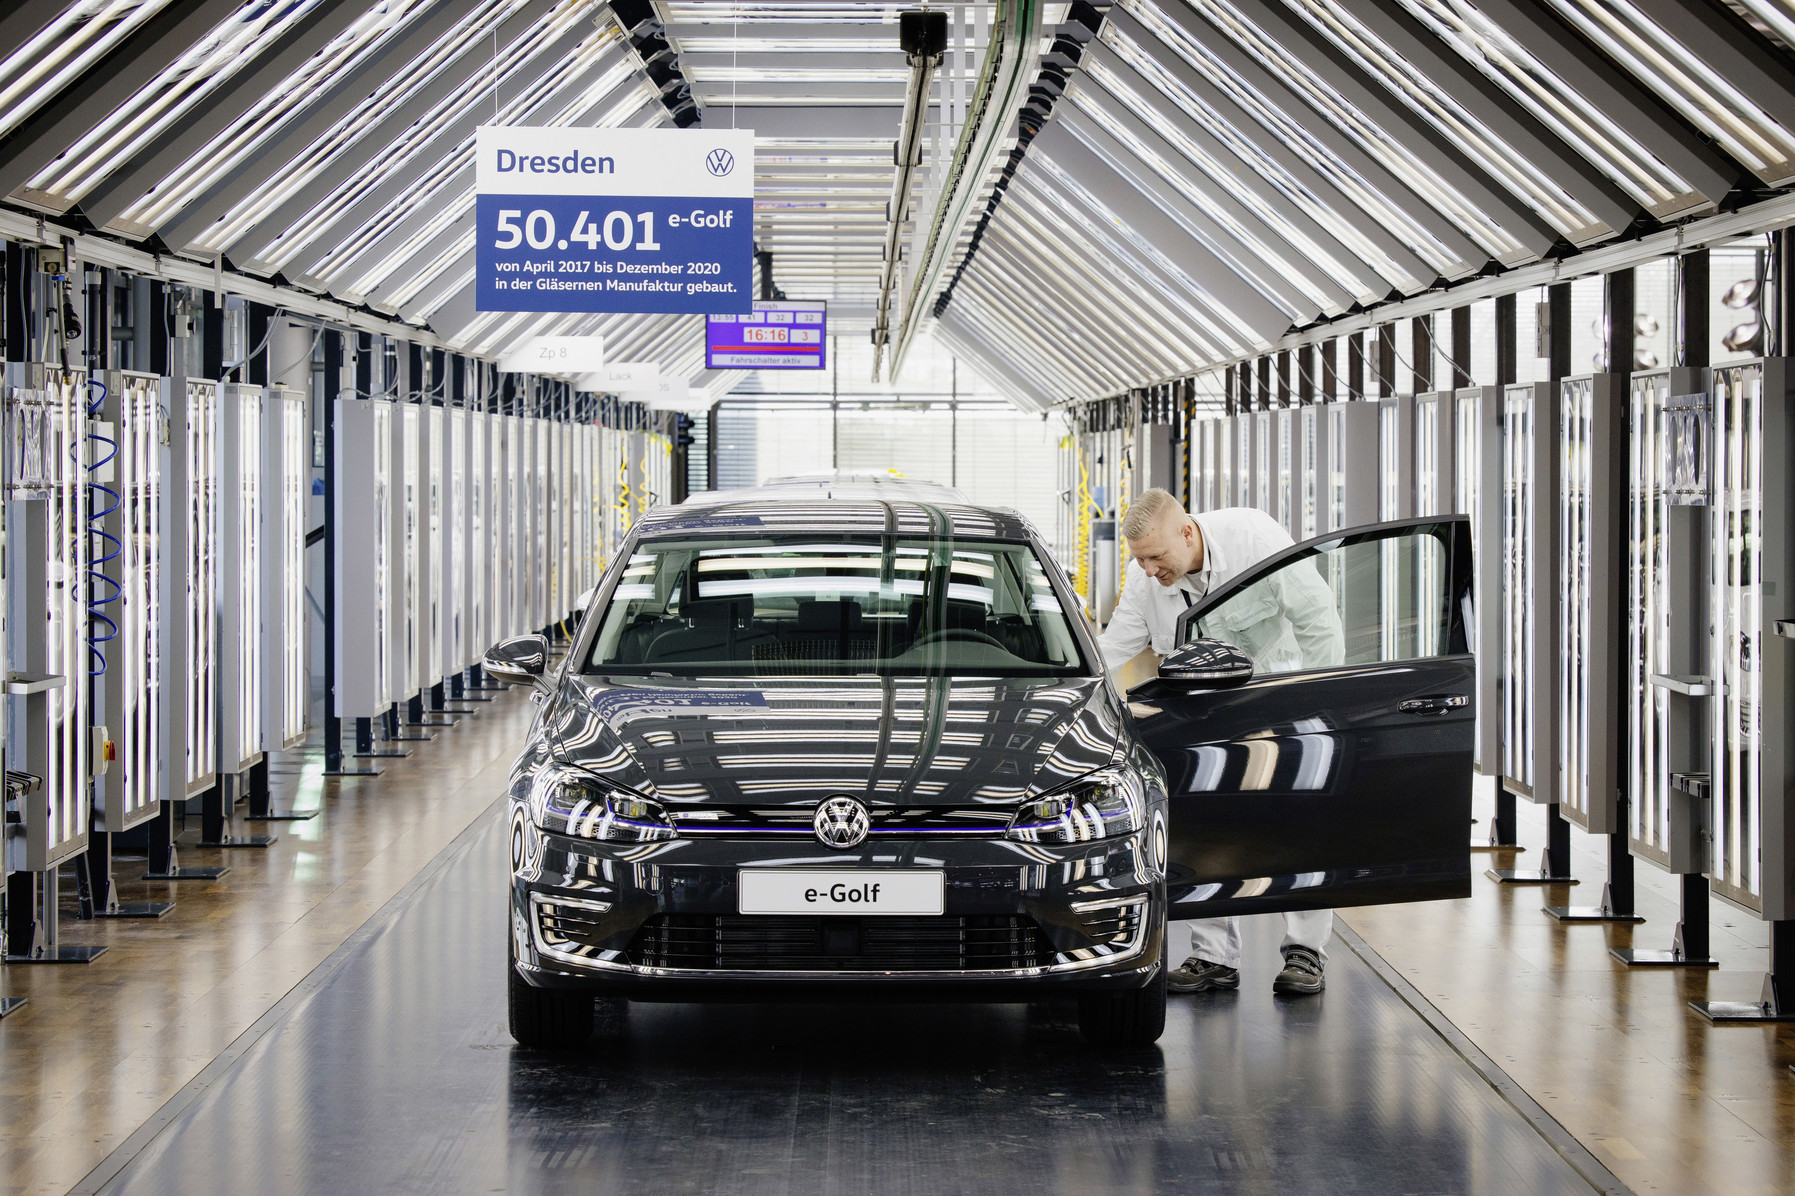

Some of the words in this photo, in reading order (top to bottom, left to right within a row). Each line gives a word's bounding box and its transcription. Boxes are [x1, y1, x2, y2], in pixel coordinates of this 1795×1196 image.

[496, 149, 615, 174] Dresden
[494, 209, 661, 251] 50.401
[668, 209, 734, 228] e-Golf
[495, 262, 520, 272] von
[522, 260, 555, 275] April
[558, 260, 591, 273] 2017
[594, 260, 614, 274] bis
[616, 261, 684, 274] Dezember
[686, 262, 721, 275] 2020
[495, 277, 508, 290] in
[510, 277, 534, 290] der
[535, 278, 603, 291] Gläsernen
[606, 279, 684, 292] Manufaktur
[686, 280, 737, 295] gebaut.
[804, 314, 814, 322] 32
[747, 328, 786, 341] 16:16
[802, 331, 809, 341] 3
[539, 347, 555, 360] Zp
[559, 347, 567, 358] 8
[730, 356, 780, 364] Fahrschalter
[609, 371, 633, 381] Lack
[804, 882, 881, 903] e-Golf
